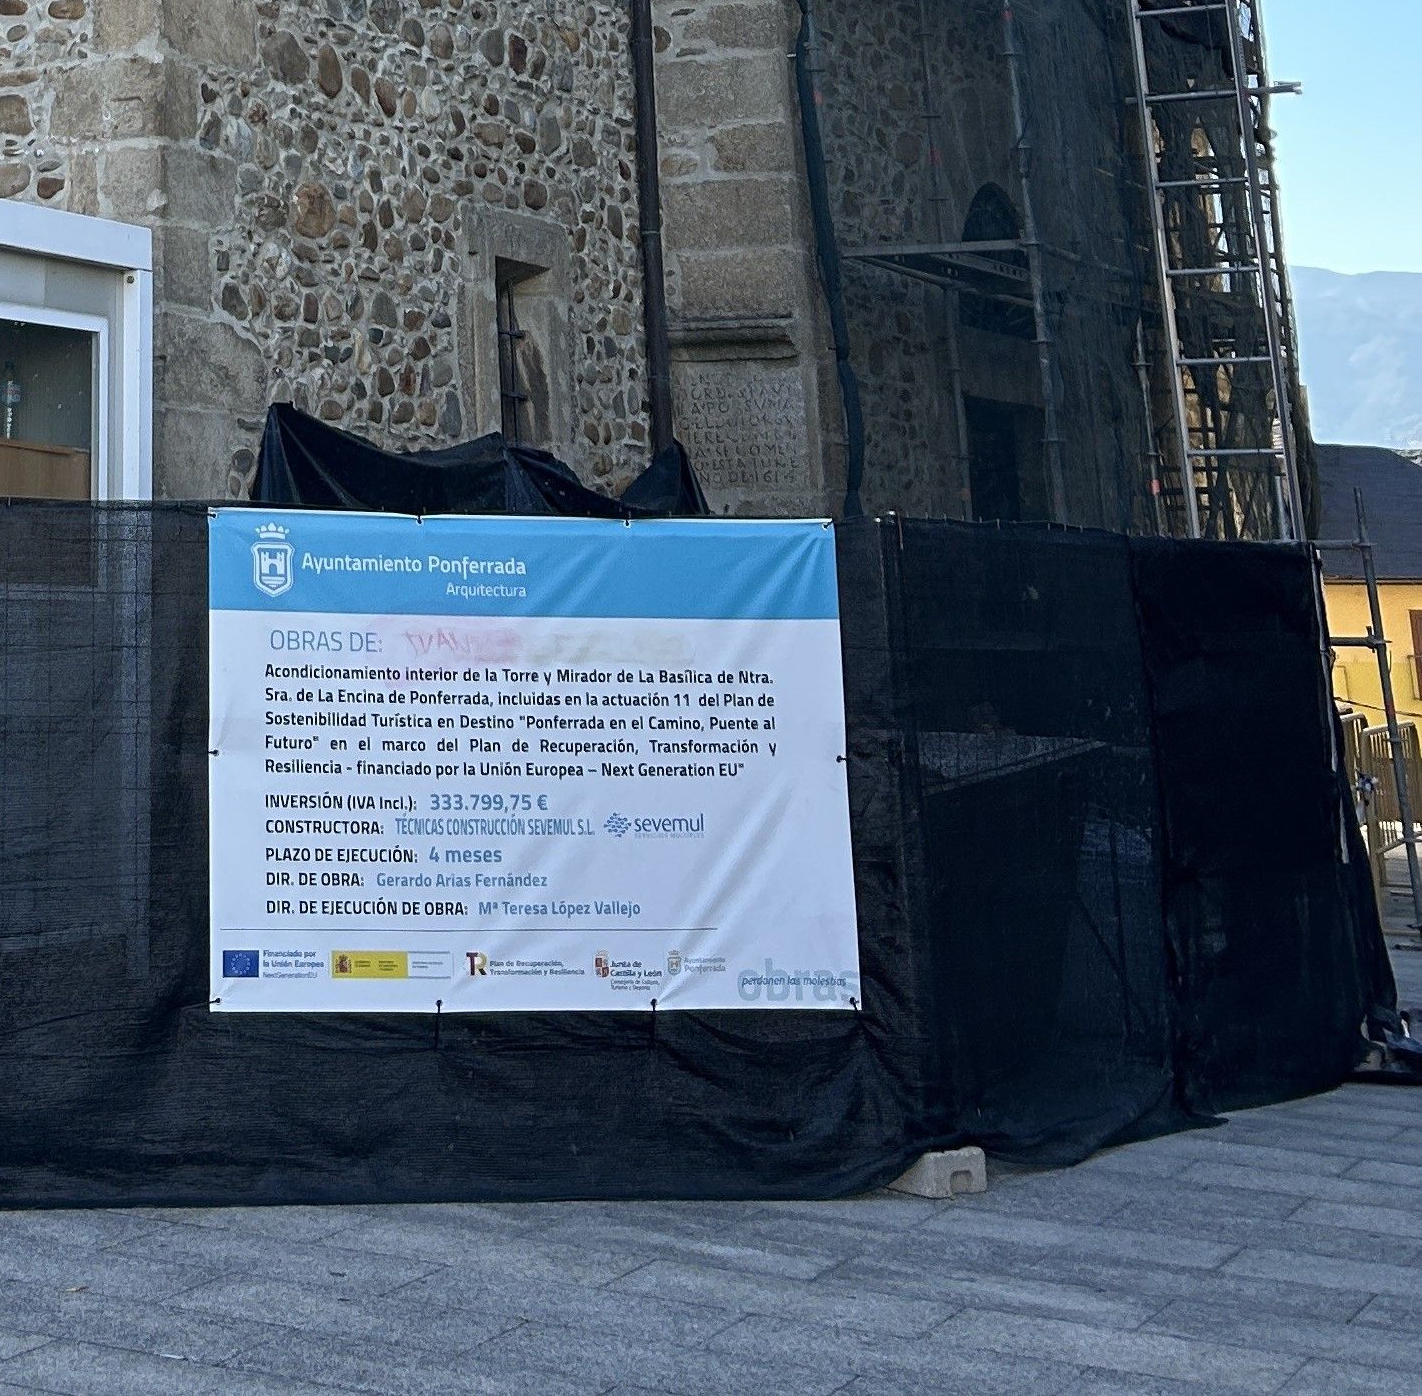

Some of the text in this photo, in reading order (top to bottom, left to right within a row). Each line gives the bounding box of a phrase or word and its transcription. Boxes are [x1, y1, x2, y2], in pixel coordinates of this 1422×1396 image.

[301, 552, 527, 580] Ayuntamiento Ponferrada
[446, 582, 527, 600] Arquitectura
[270, 629, 383, 653] OBRAS DE:
[265, 663, 773, 686] Acondicionamiento interior de la Torre y Mirador de La Basílica de Ntra.
[265, 688, 775, 707] Sra. de La Encina de Ponferrada, incluidas en la actuación 11 del Plan de
[265, 711, 776, 732] Sostenibilidad Turística en Destino "Ponferrada en el Camino, Puente al
[330, 738, 347, 750] en
[358, 736, 371, 751] el
[382, 738, 426, 752] marco
[437, 737, 458, 752] del
[469, 738, 501, 752] Plan
[512, 738, 529, 753] de
[540, 739, 639, 755] Recuperación,
[649, 739, 758, 754] Transformación
[768, 742, 777, 756] y
[265, 758, 342, 774] Resiliencia
[356, 760, 432, 776] financiado
[435, 764, 459, 780] por
[463, 762, 476, 776] la
[480, 761, 521, 777] Unión
[526, 762, 584, 780] Europea
[601, 763, 634, 777] Next
[638, 763, 715, 777] Generation
[265, 791, 548, 813] INVERSIÓN (IVA Incl.): 333.799,75 €
[265, 812, 595, 836] CONSTRUCTORA: TÉCNICAS CONSTRUCCIÓN SEVEMUL S.L.
[634, 813, 704, 832] sevemul
[265, 845, 502, 863] PLAZO DE EJECUCIÓN: 4 meses
[266, 872, 548, 888] DIR. DE OBRA: Gerardo Arias Fernández
[266, 900, 294, 914] DIR.
[299, 901, 317, 914] DE
[321, 897, 398, 915] EJECUCIÓN
[402, 902, 420, 915] DE
[424, 902, 468, 916] OBRA:
[503, 902, 548, 916] Teresa
[552, 901, 591, 918] López
[593, 901, 641, 918] Vallejo
